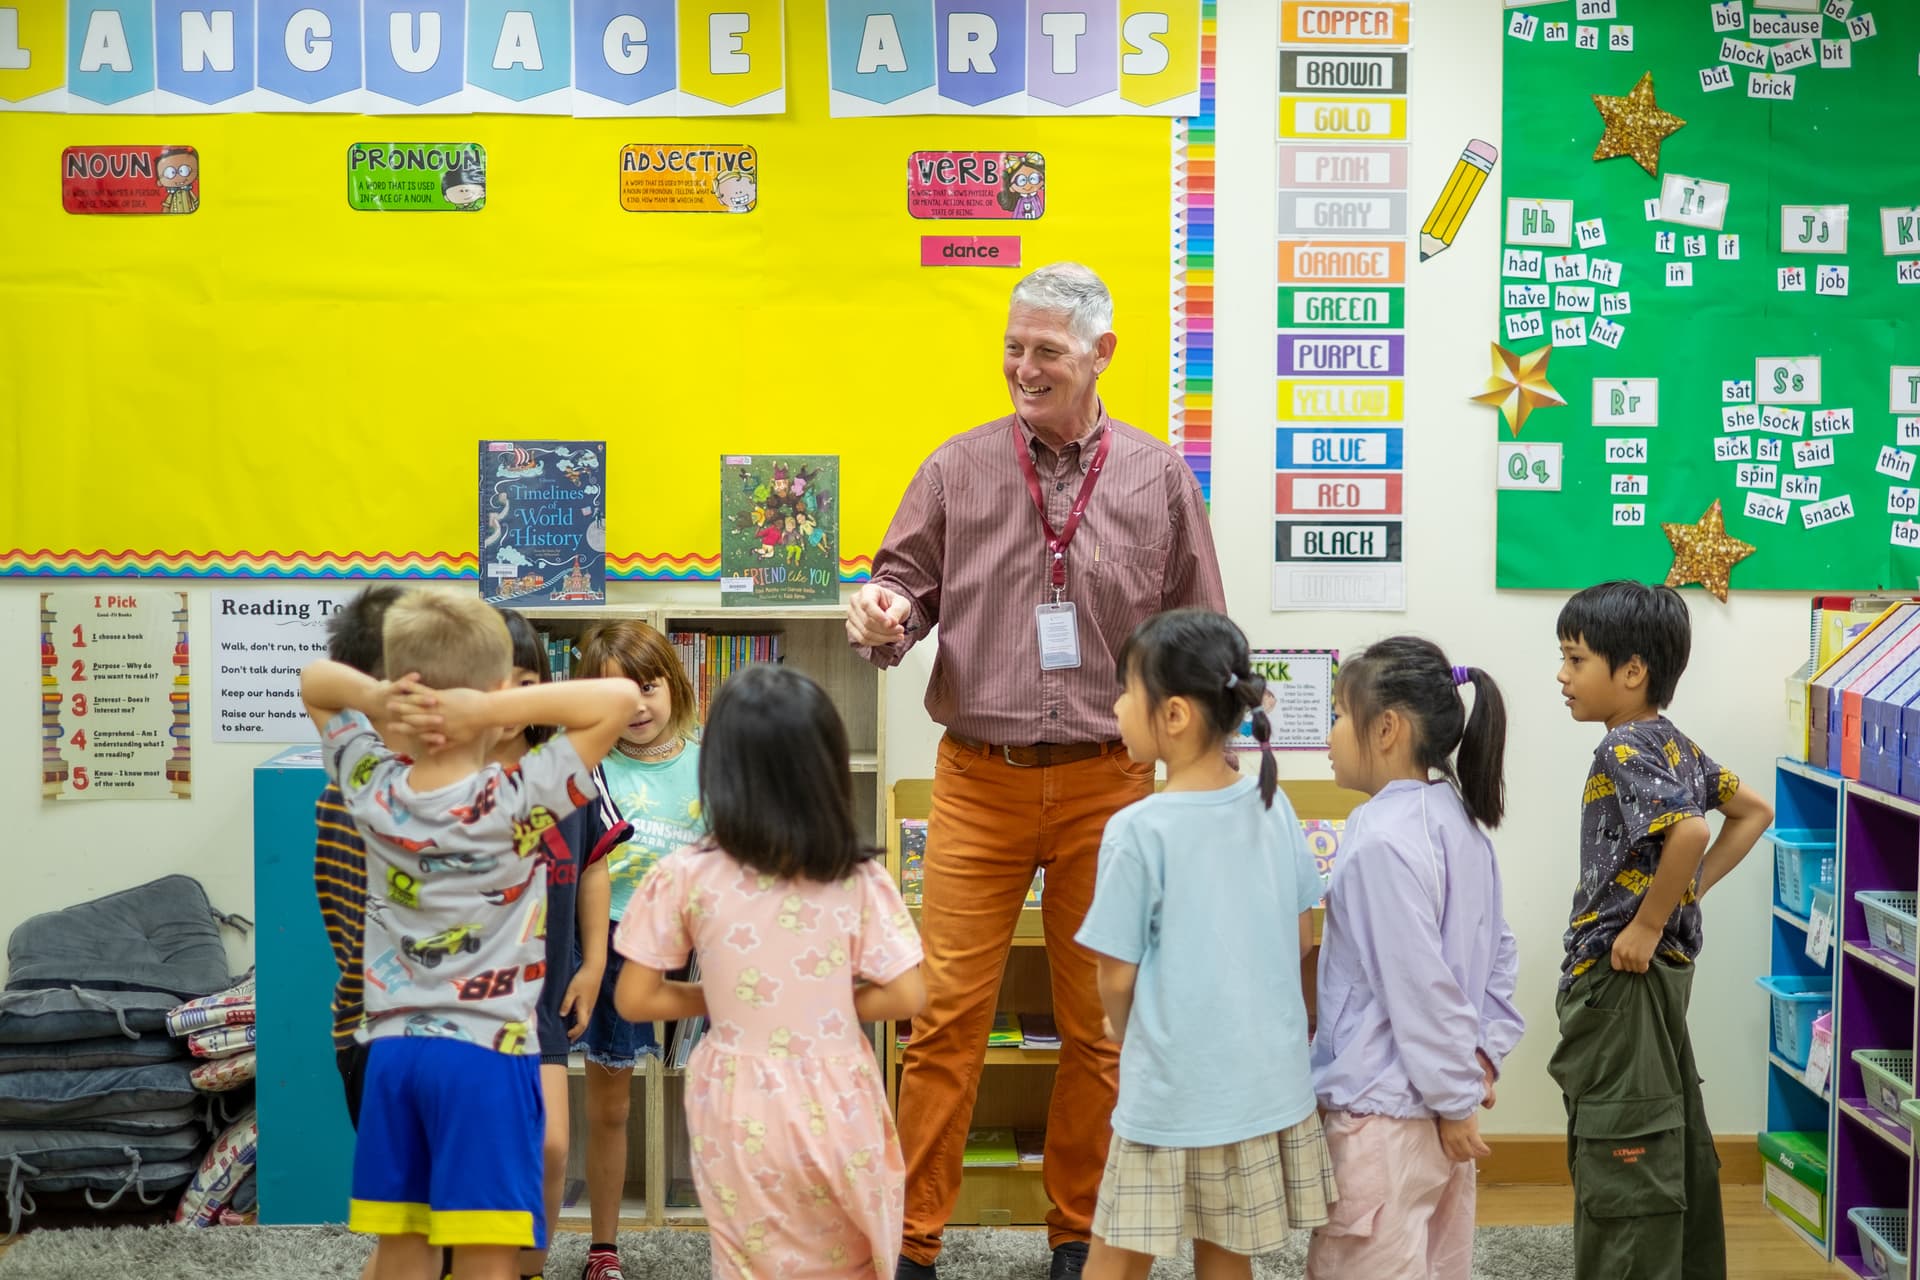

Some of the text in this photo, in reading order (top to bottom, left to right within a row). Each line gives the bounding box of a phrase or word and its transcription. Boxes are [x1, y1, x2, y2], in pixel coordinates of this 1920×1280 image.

[1582, 0, 1611, 14] and
[1826, 1, 1846, 20] be
[1302, 10, 1389, 36] COPPER
[1716, 9, 1742, 28] big
[1753, 19, 1820, 34] because
[1851, 20, 1873, 38] by
[0, 8, 1169, 75] LANGUAGE ARTS
[1513, 21, 1629, 48] all an at as
[1722, 44, 1844, 67] block back bit
[1306, 60, 1382, 87] BROWN
[1702, 70, 1792, 97] but brick
[1314, 106, 1372, 133] GOLD
[67, 152, 153, 178] NOUN
[351, 148, 481, 170] PRONOUN
[1315, 156, 1370, 182] PINK
[358, 181, 436, 192] A WORD THAT IS USED
[359, 193, 432, 204] IN OF A NOUN
[1680, 188, 1705, 215] Ii
[1314, 201, 1372, 228] GRAY
[1522, 208, 1555, 235] Hh
[1580, 225, 1601, 242] he
[1798, 216, 1829, 244] Jj
[942, 242, 1000, 259] dance
[1660, 236, 1734, 256] it is if
[1298, 251, 1384, 277] ORANGE
[1508, 258, 1612, 283] had hat hit
[1670, 267, 1684, 281] in
[1781, 270, 1845, 292] jet job
[1306, 297, 1378, 322] GREEN
[1508, 291, 1627, 312] have how his
[1511, 317, 1618, 345] hop hot hut
[1298, 344, 1384, 369] PURPLE
[1774, 367, 1804, 394] Ss
[1296, 388, 1386, 415] YELLOW
[1610, 389, 1640, 415] Rr
[1726, 384, 1750, 399] sat
[1727, 412, 1850, 432] she sock stick
[1311, 438, 1367, 462] BLUE
[1610, 443, 1644, 458] rock
[1717, 442, 1830, 462] sick sit said
[1508, 453, 1549, 483] Qq
[1881, 452, 1911, 475] thin
[509, 484, 584, 500] Timelines
[1615, 481, 1640, 494] ran
[1740, 469, 1818, 494] spin skin
[547, 500, 558, 510] of
[1318, 484, 1361, 508] RED
[1890, 494, 1915, 512] top
[514, 504, 574, 527] World
[1615, 507, 1641, 522] rob
[1748, 500, 1851, 526] sack snack
[509, 526, 584, 552] History
[1895, 522, 1918, 542] tap
[1304, 530, 1374, 556] BLACK
[744, 566, 786, 586] FRIEND
[788, 570, 808, 583] like
[810, 568, 830, 586] YOU
[94, 595, 137, 608] I Pick
[222, 599, 310, 620] Reading
[72, 624, 87, 648] 1
[221, 642, 328, 652] Walk, don't run, to the
[71, 659, 88, 682] 2
[92, 662, 152, 671] Purpose Why do
[132, 672, 148, 680] read
[149, 672, 159, 680] it?
[221, 665, 302, 677] Don't talk during
[221, 688, 245, 699] Keep
[247, 690, 264, 698] our
[266, 689, 295, 698] hands
[72, 693, 88, 717] 3
[221, 709, 247, 719] Raise
[248, 711, 266, 719] our
[267, 709, 297, 719] hands
[93, 730, 135, 738] Comprehend
[222, 723, 264, 732] to share.
[70, 729, 87, 750] 4
[93, 740, 142, 749] understanding
[105, 751, 135, 759] reading?
[73, 766, 89, 790] 5
